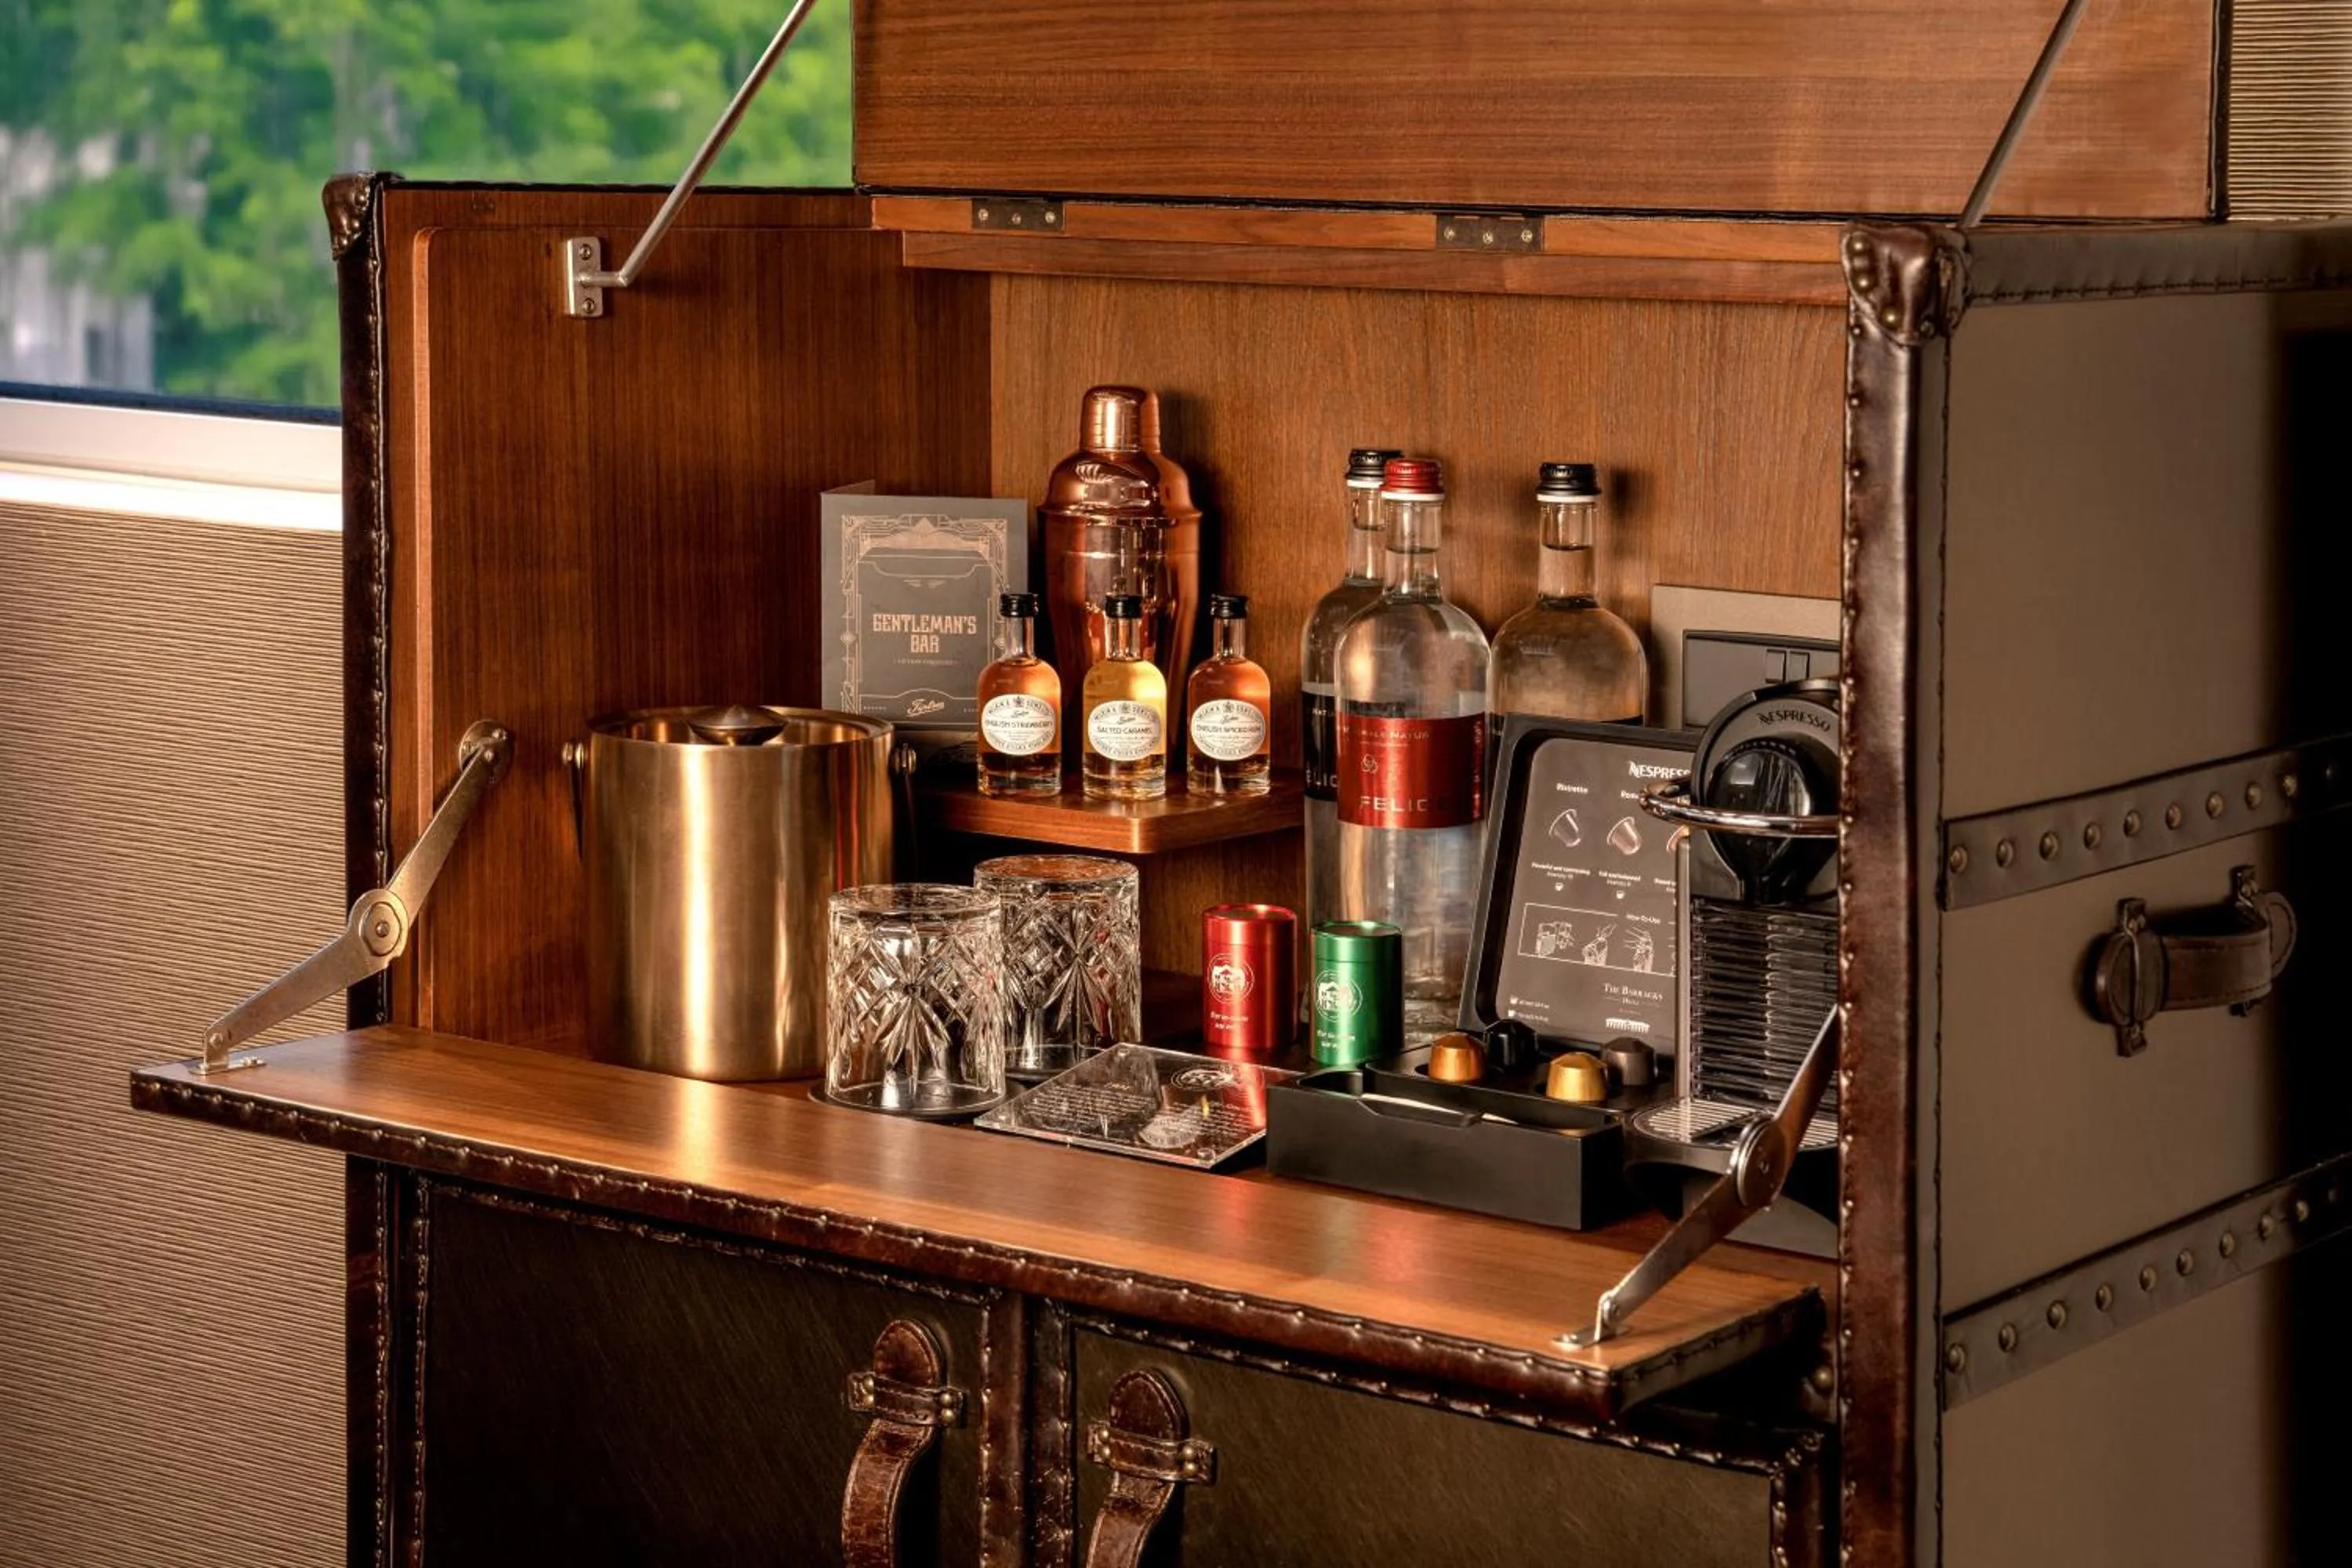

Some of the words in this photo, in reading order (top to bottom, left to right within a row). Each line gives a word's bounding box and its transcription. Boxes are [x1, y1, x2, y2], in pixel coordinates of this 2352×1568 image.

[873, 614, 977, 633] GENTLEMAN'S
[910, 635, 939, 653] BAR
[1756, 710, 1831, 732] NESPRESSO
